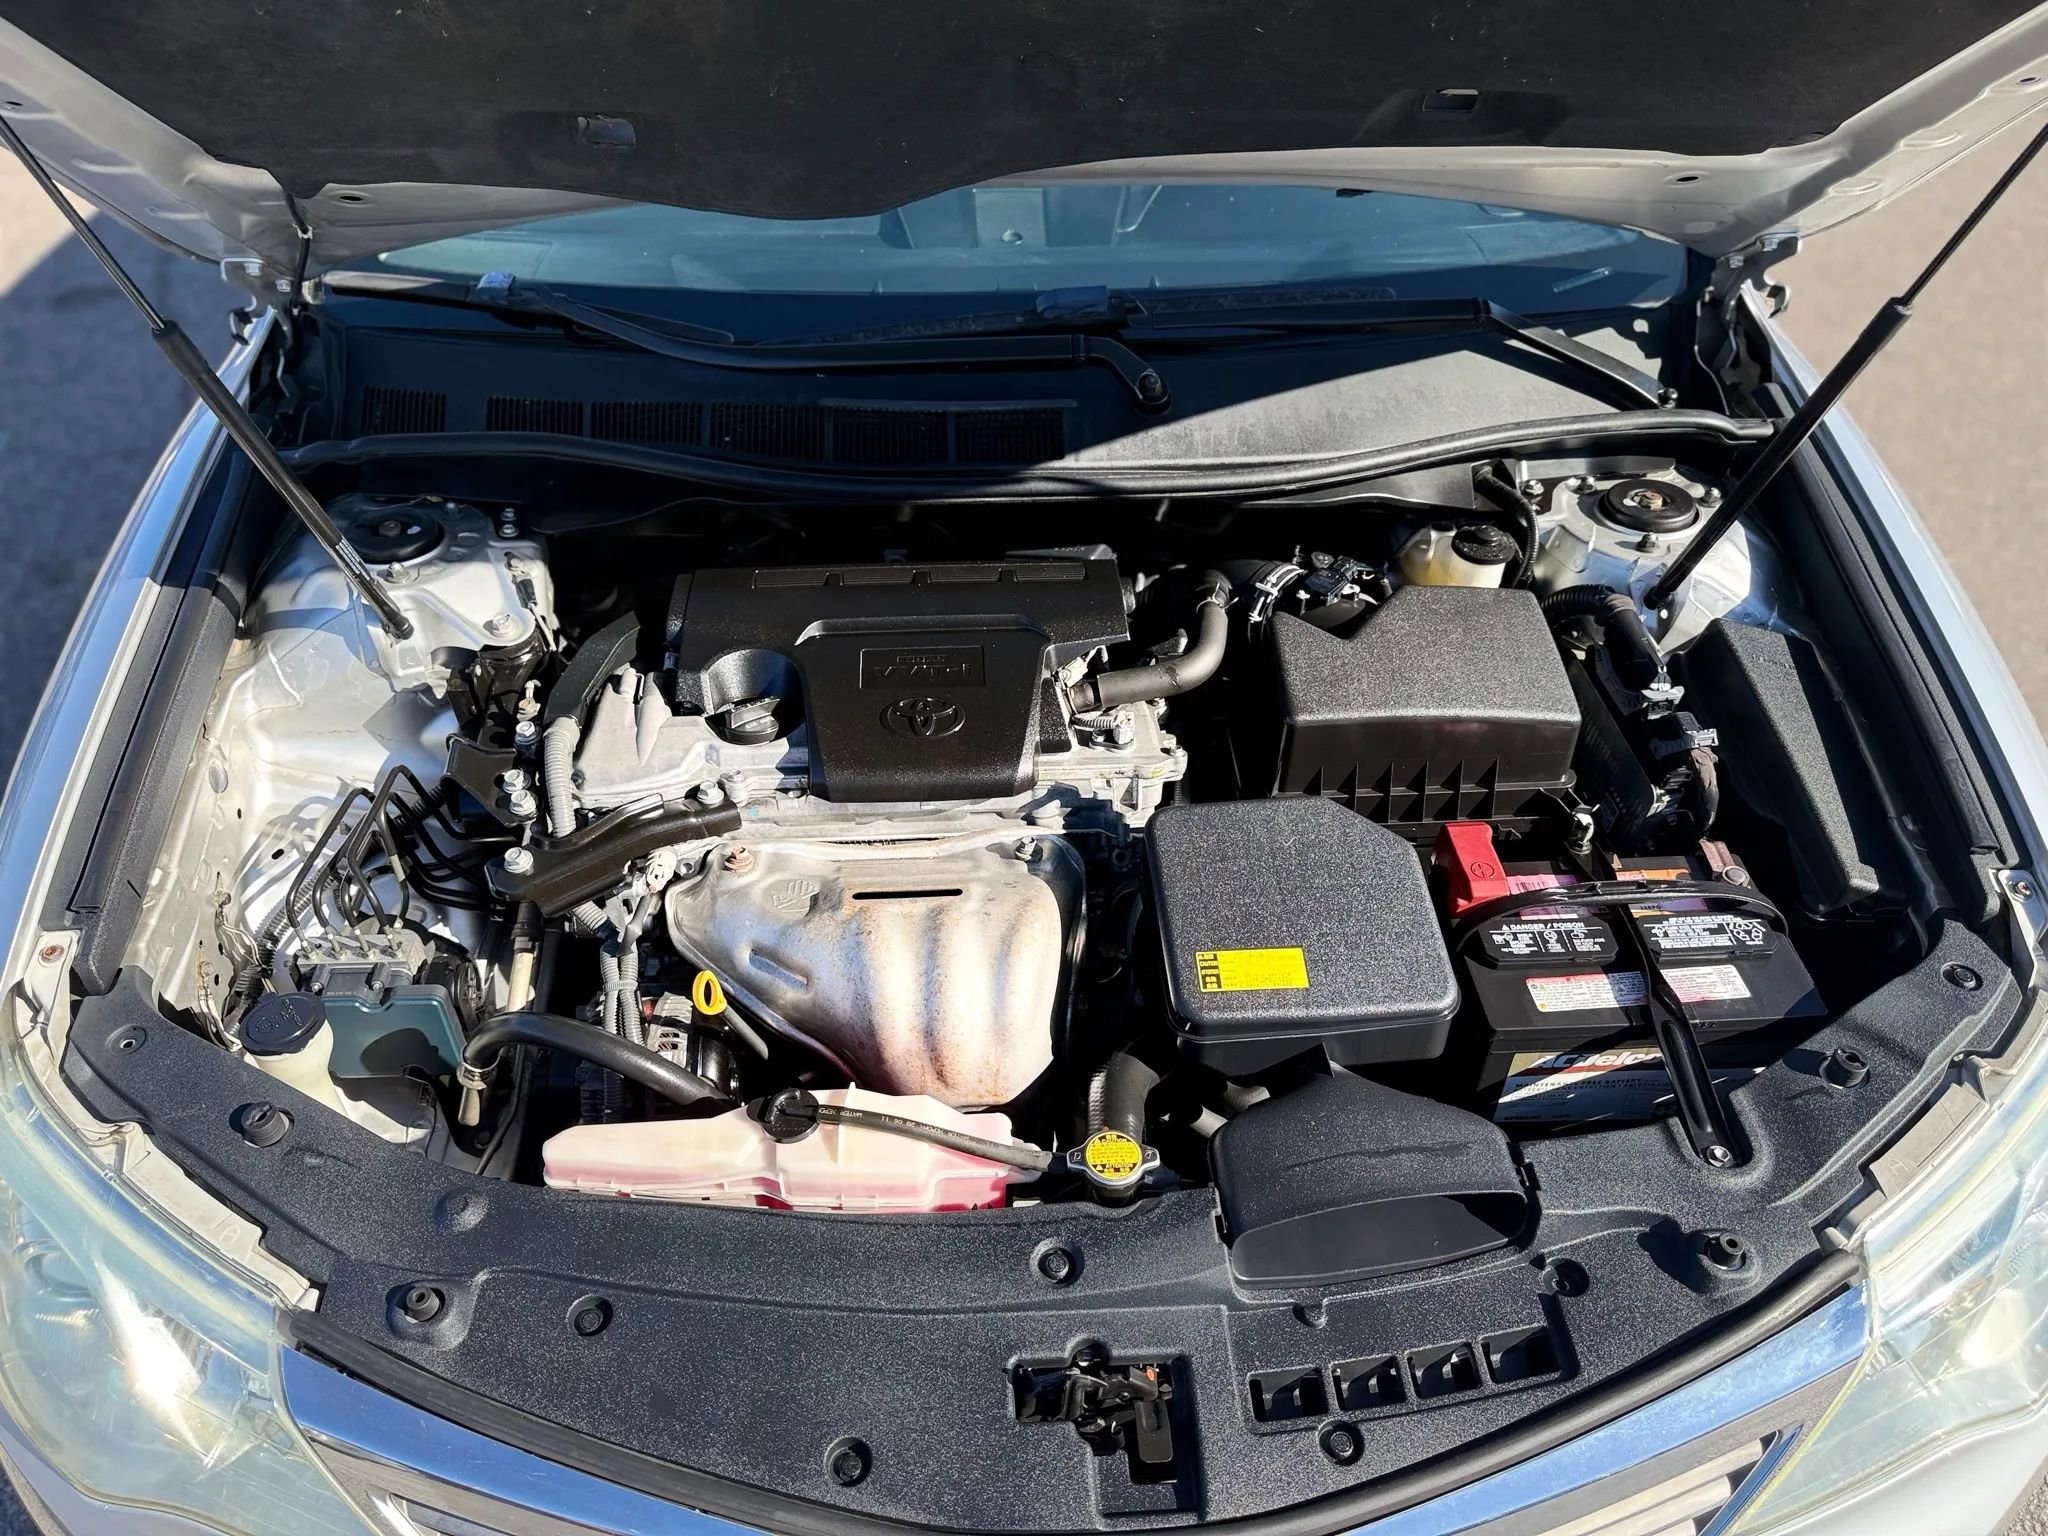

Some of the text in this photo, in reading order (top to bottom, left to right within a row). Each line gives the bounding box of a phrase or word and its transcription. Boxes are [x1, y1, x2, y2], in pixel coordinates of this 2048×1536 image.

[1510, 923, 1545, 931] DANGER
[1553, 921, 1585, 930] POISON
[1530, 1052, 1664, 1068] ACDelco
